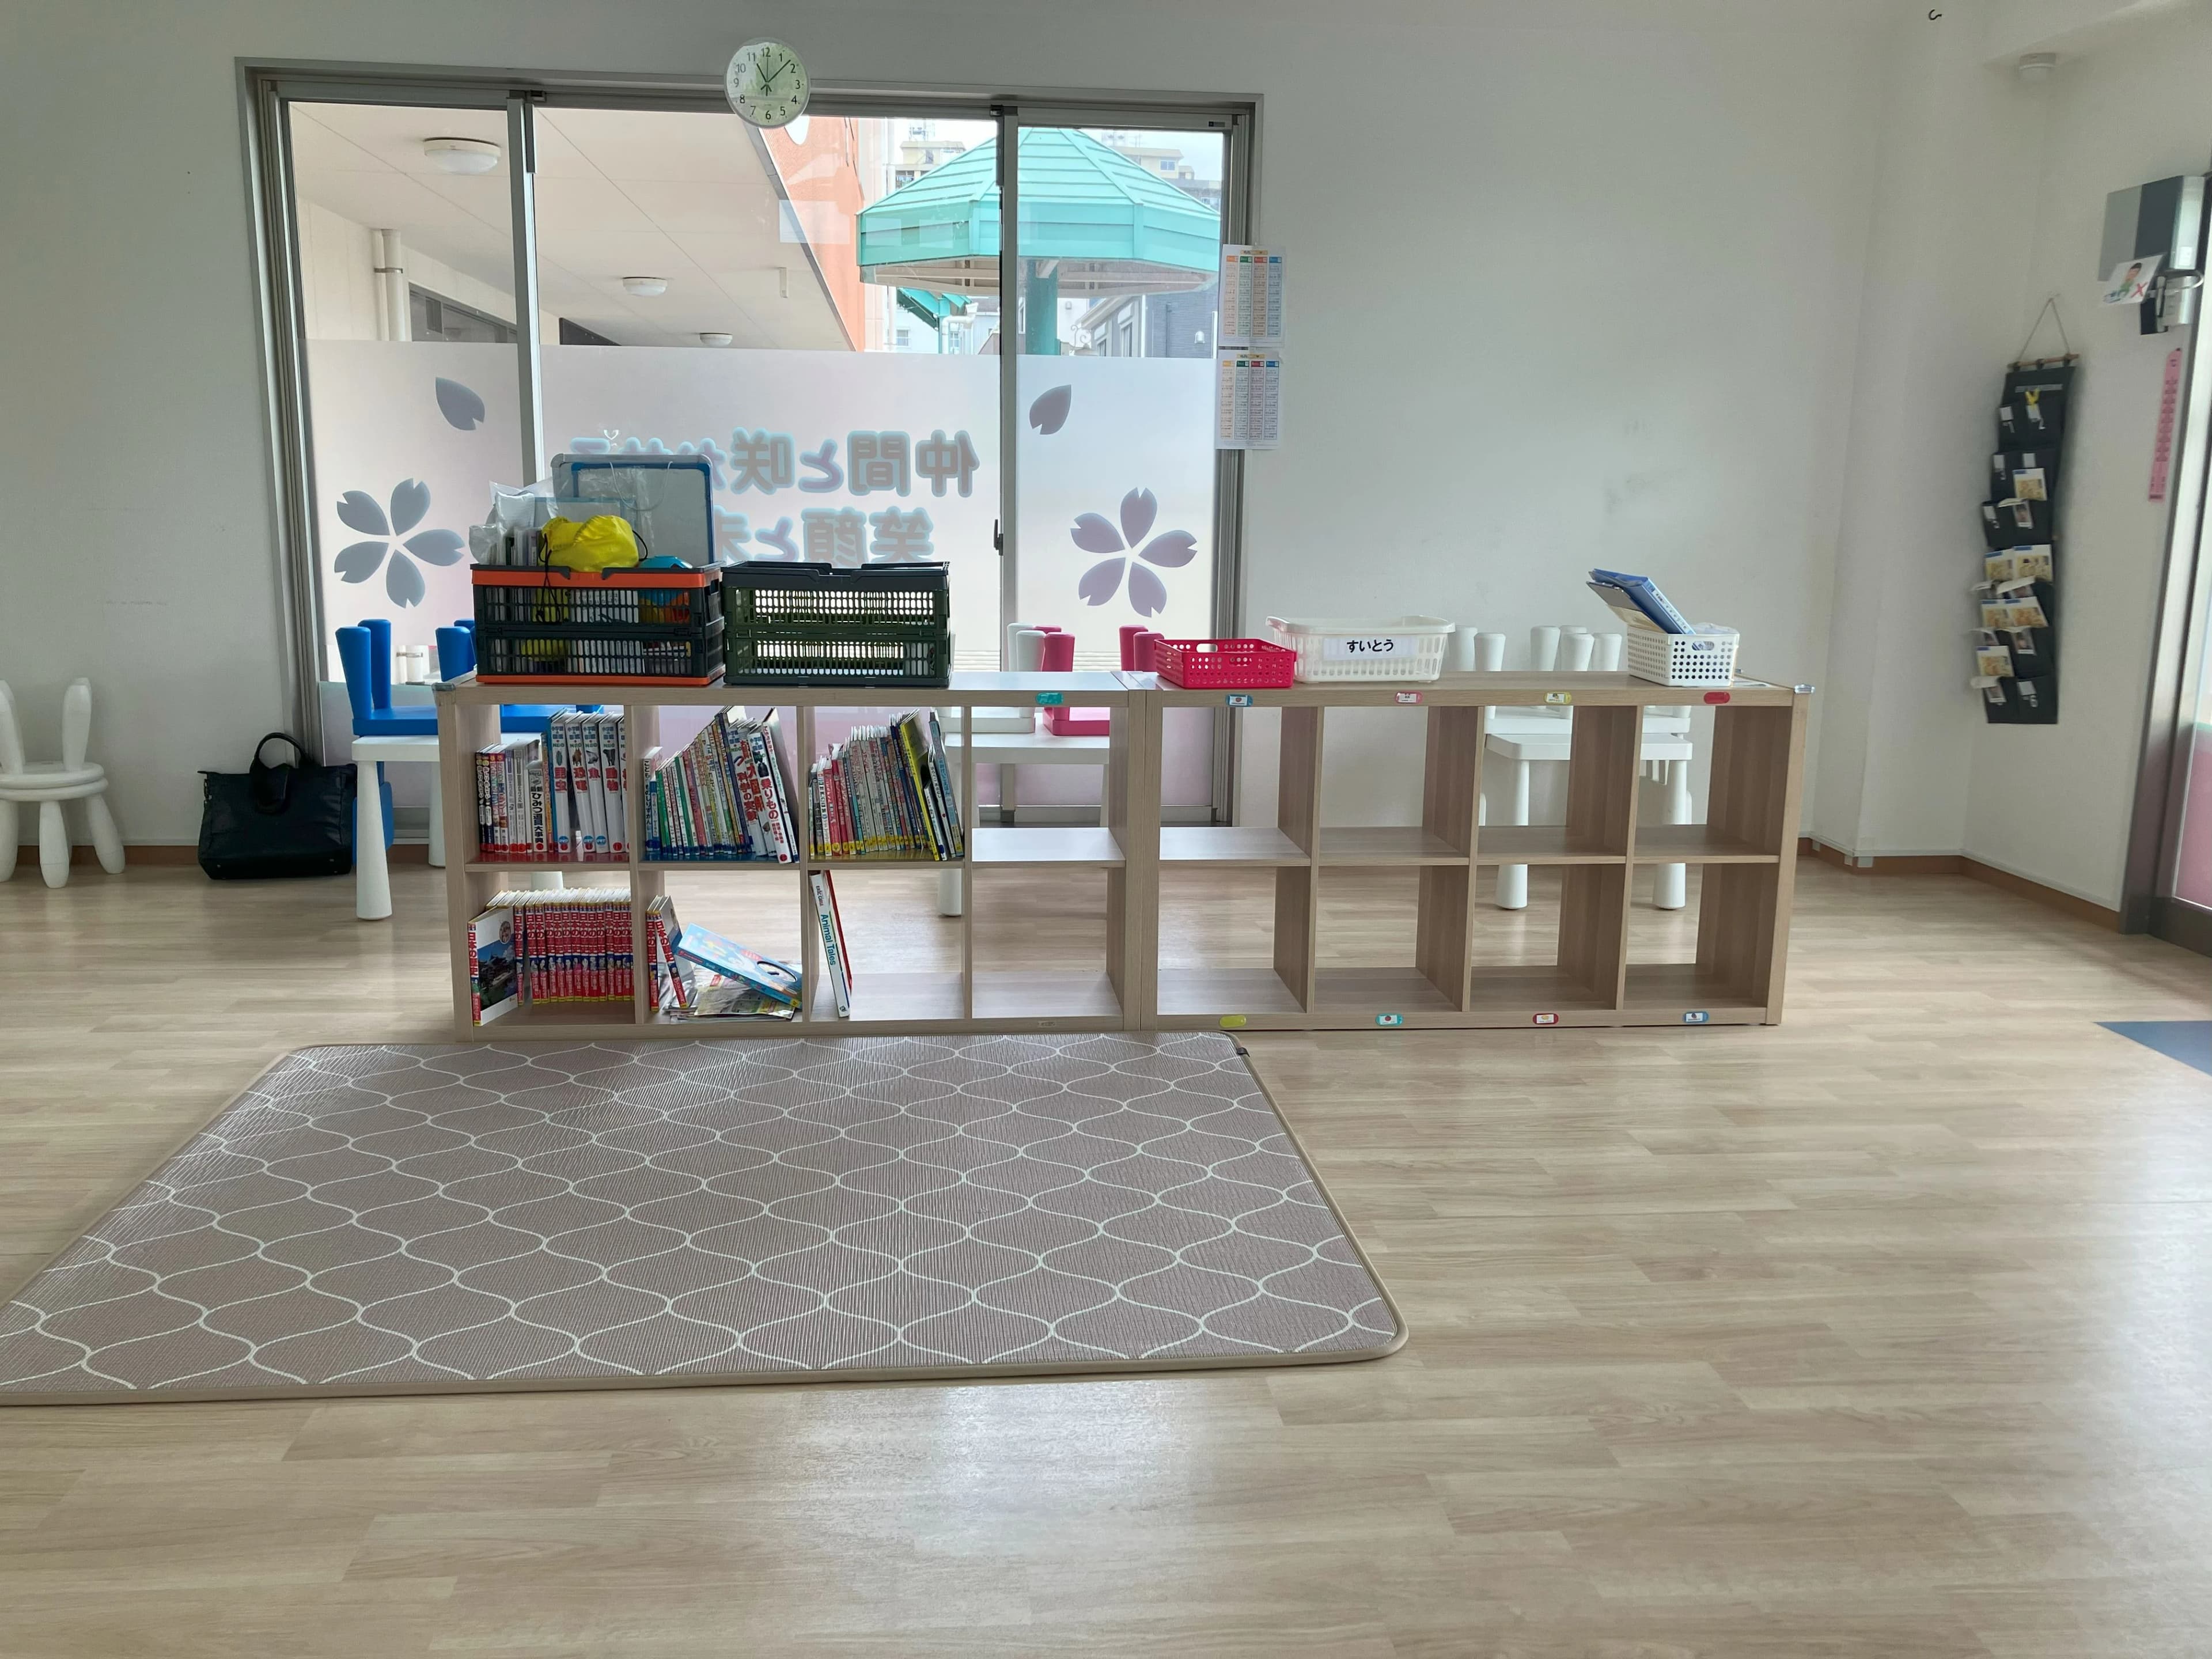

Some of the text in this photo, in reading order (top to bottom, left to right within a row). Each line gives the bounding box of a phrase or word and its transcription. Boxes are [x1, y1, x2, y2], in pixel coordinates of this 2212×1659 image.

[747, 52, 756, 62] 11
[761, 47, 771, 57] 12
[779, 53, 783, 62] 1
[736, 63, 747, 73] 10
[790, 64, 796, 74] 2
[734, 78, 739, 88] 9
[795, 80, 801, 89] 3
[740, 94, 746, 104] 8
[791, 95, 798, 104] 4
[751, 106, 756, 115] 7
[766, 111, 771, 120] 6
[780, 106, 786, 116] 5
[1347, 639, 1394, 653] すいとう
[761, 778, 779, 819] 乗りもの
[821, 914, 836, 965] Animal Tales
